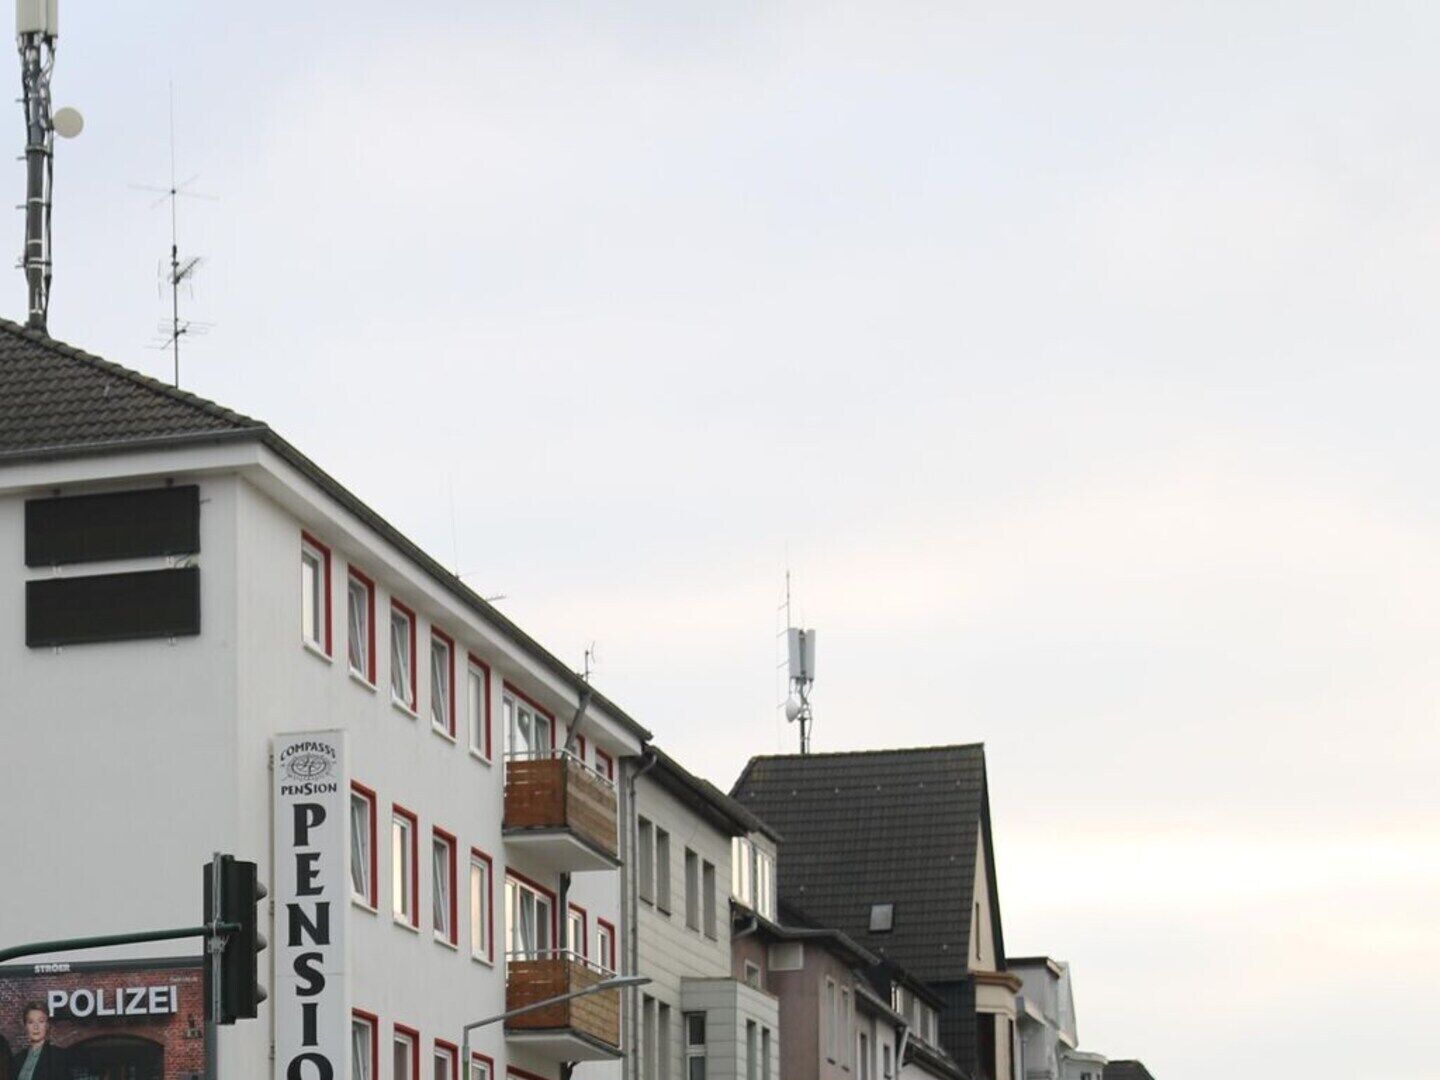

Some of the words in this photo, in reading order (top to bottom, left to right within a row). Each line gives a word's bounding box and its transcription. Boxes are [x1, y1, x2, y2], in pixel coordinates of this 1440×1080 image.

[280, 782, 337, 796] PENSION
[34, 963, 71, 974] STRÖER
[47, 985, 178, 1018] POLIZEI
